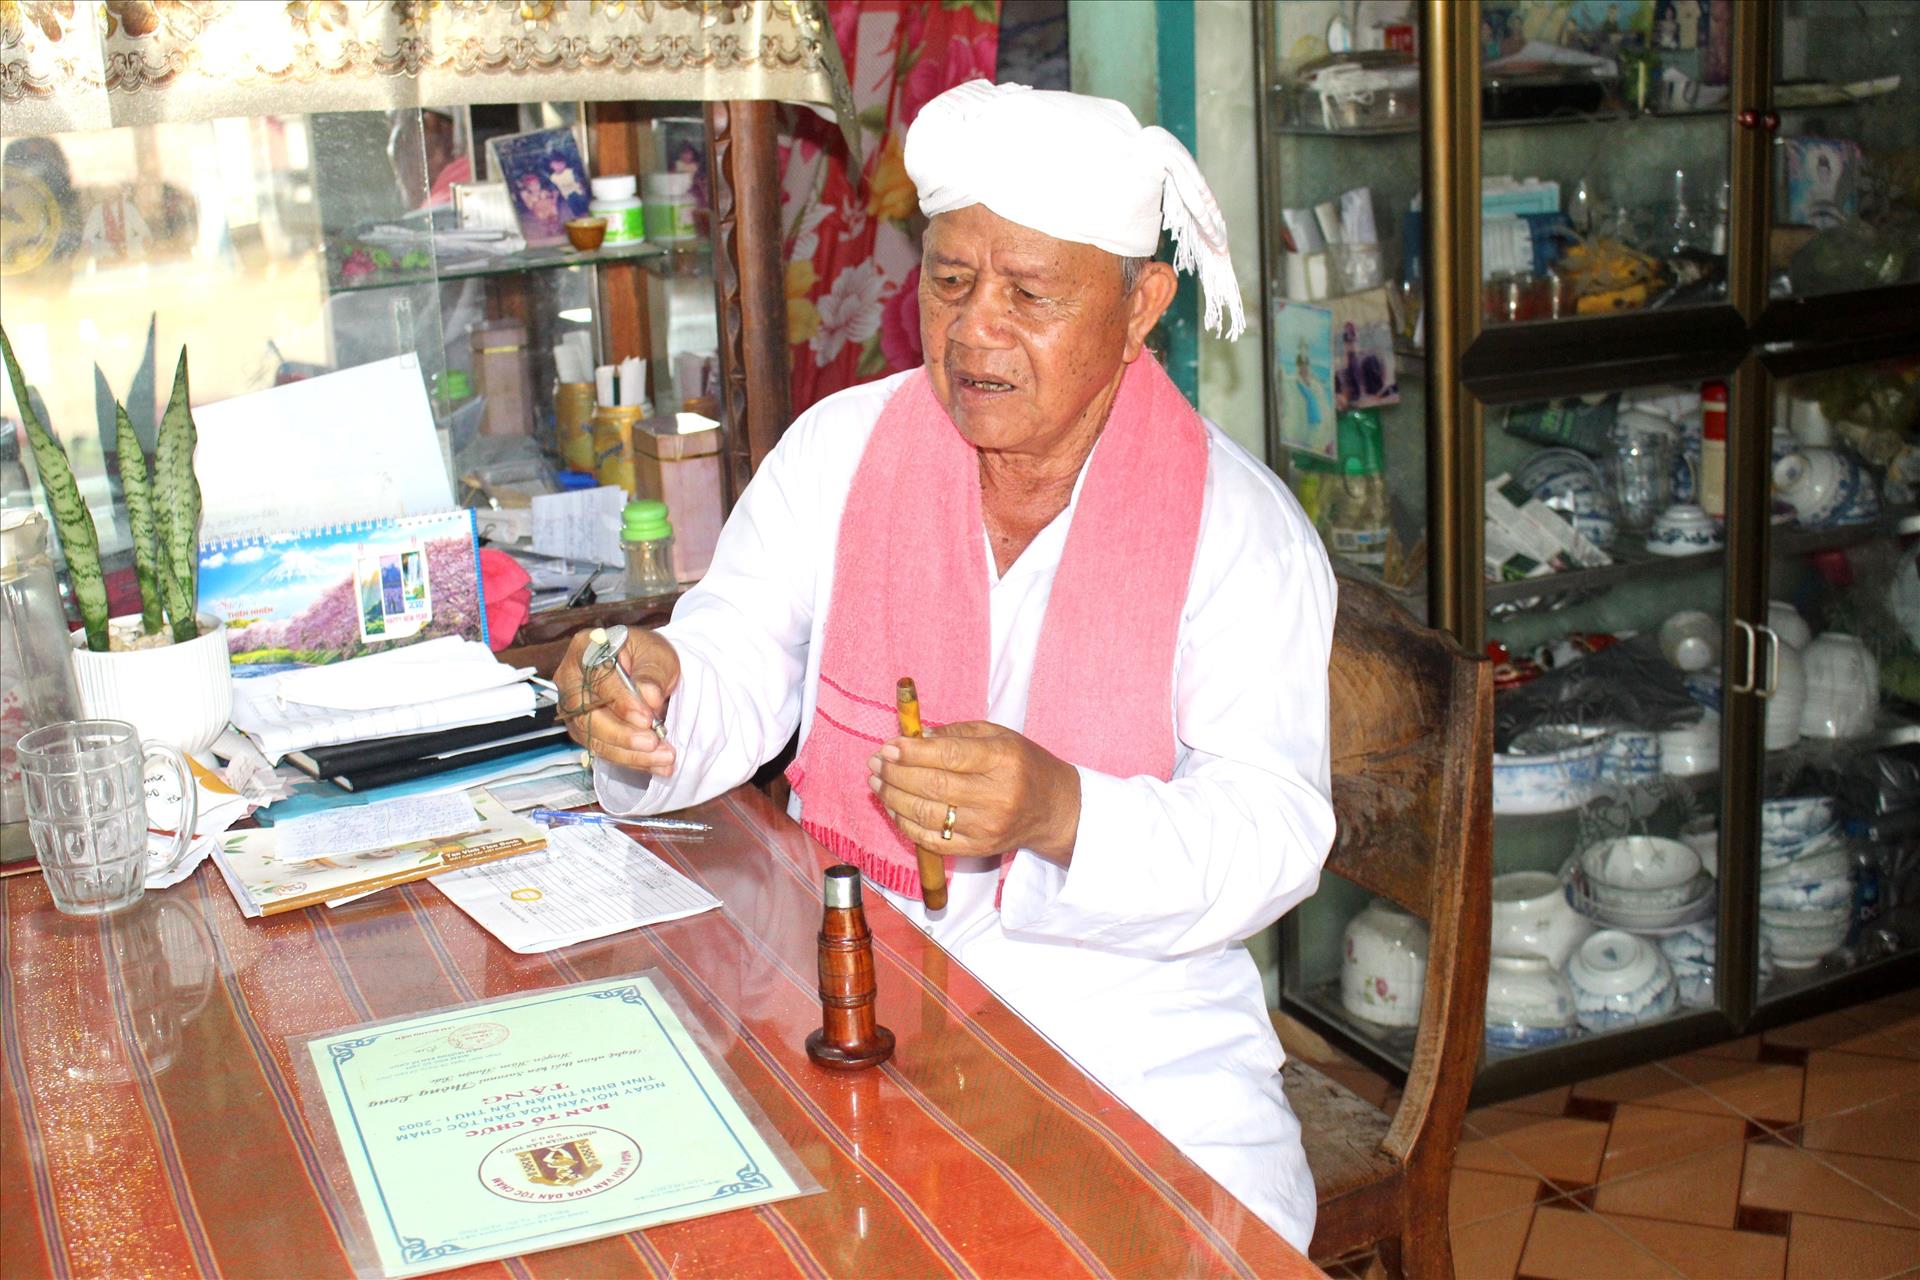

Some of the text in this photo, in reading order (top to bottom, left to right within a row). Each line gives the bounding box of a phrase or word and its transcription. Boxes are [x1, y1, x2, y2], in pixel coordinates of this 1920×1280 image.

[621, 1075, 655, 1086] TỈNH
[482, 1083, 569, 1105] TẶNG
[581, 1083, 617, 1094] BÌNH
[368, 1094, 413, 1108] Long
[525, 1091, 576, 1105] THUẬN
[396, 1082, 666, 1142] NGÀY HỘI VĂN HÓA DÂN TỘC CHĂM
[490, 1102, 520, 1112] LẦN
[455, 1109, 484, 1120] THỨ
[465, 1103, 610, 1137] BAN TỔ CHỨC
[398, 1120, 432, 1132] 2003
